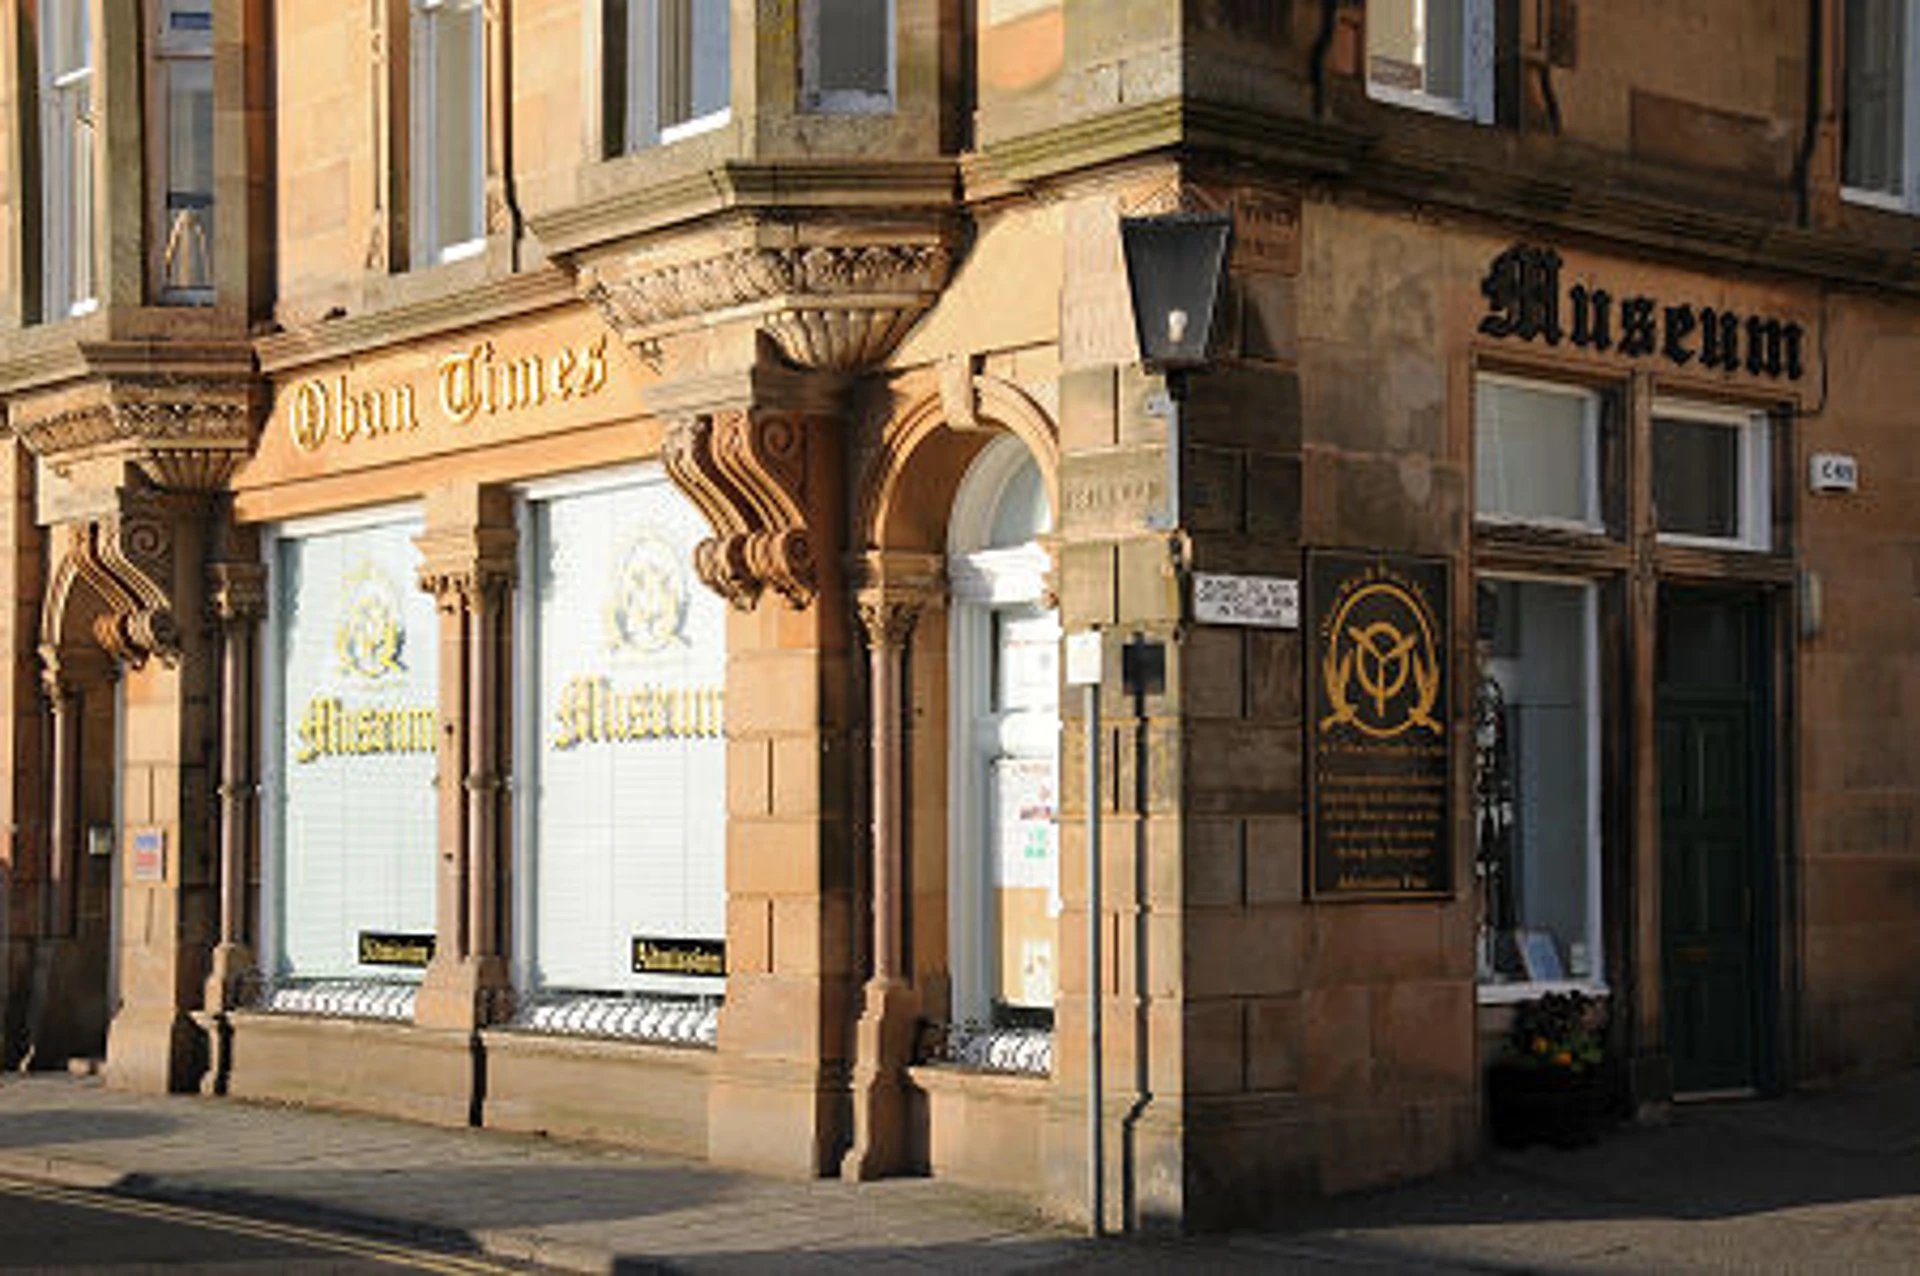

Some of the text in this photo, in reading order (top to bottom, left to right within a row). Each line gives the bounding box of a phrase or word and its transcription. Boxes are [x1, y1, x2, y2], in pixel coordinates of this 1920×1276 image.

[1479, 242, 1803, 380] Museum
[289, 336, 608, 451] Oban Times
[297, 696, 437, 763] Museum
